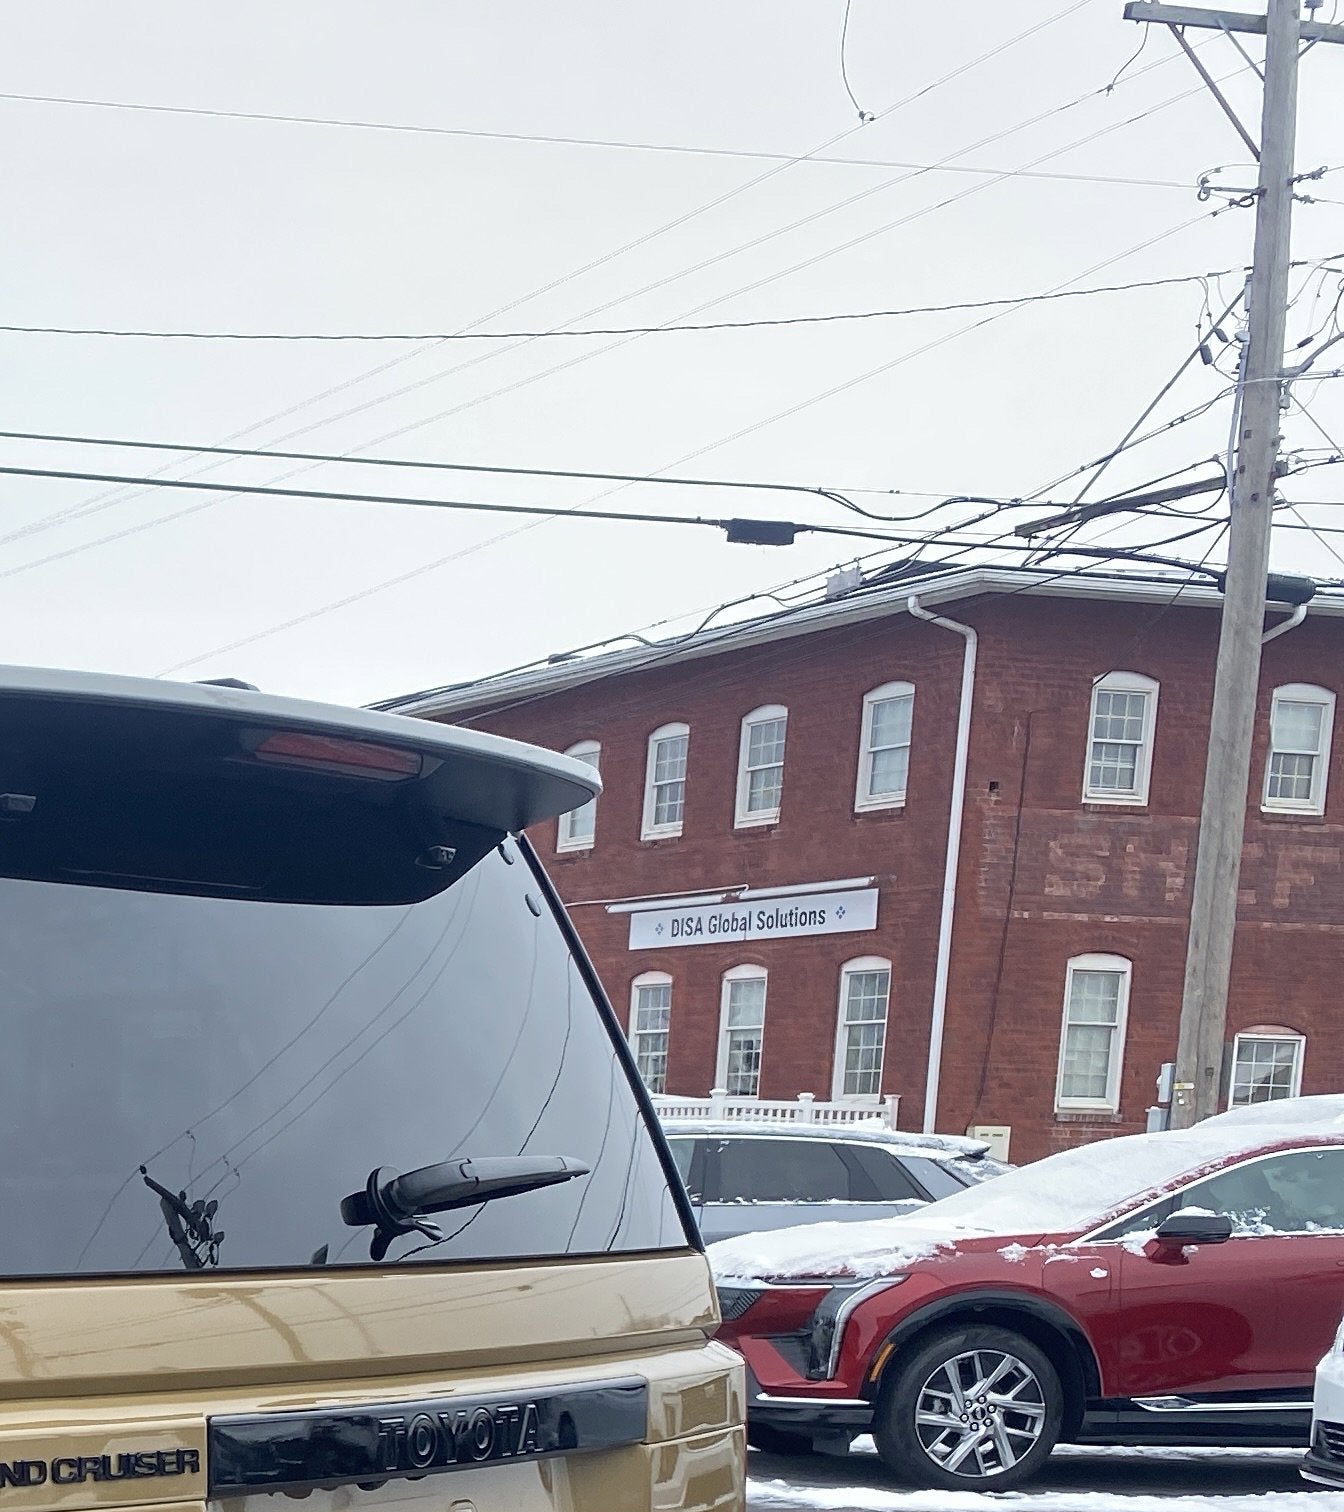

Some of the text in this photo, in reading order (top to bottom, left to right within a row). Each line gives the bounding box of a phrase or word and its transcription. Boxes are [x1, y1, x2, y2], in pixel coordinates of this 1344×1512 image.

[671, 906, 826, 938] DISA Global Solutions
[378, 1404, 544, 1470] TOYOTA
[51, 1448, 200, 1485] CRUISER
